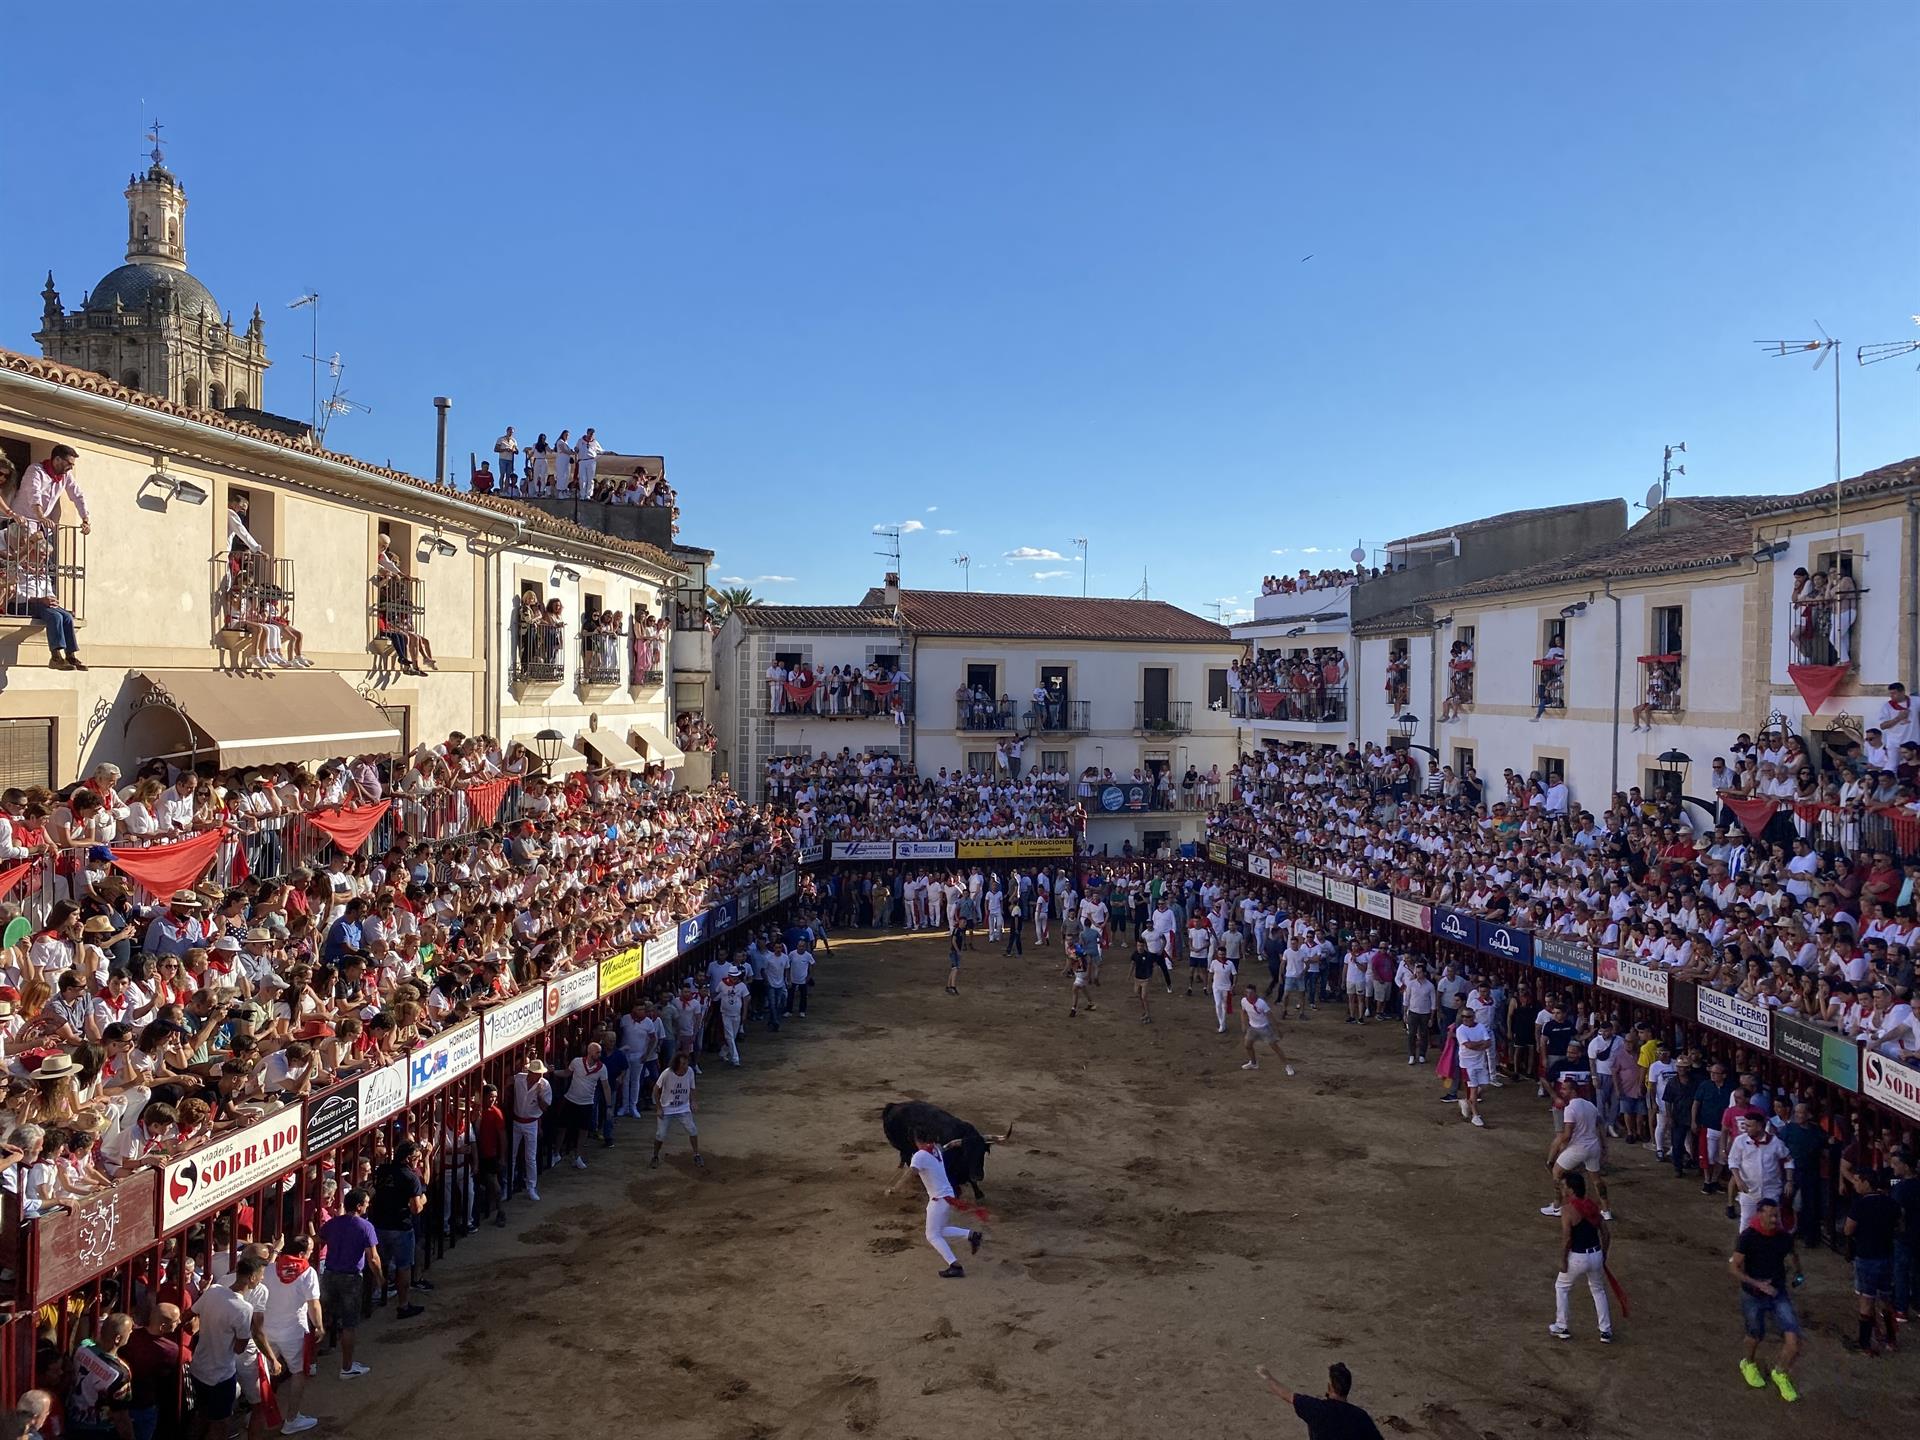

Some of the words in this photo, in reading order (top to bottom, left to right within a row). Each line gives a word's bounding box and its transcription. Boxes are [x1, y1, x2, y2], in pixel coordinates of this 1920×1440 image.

[1544, 942, 1564, 956] DENTAL
[1568, 949, 1593, 963] ARGEME
[560, 980, 577, 996] EURO
[578, 971, 596, 986] REPAR
[1622, 976, 1666, 998] MONCAR
[200, 1124, 298, 1190] SOBRADO
[201, 1143, 234, 1165] Maderas
